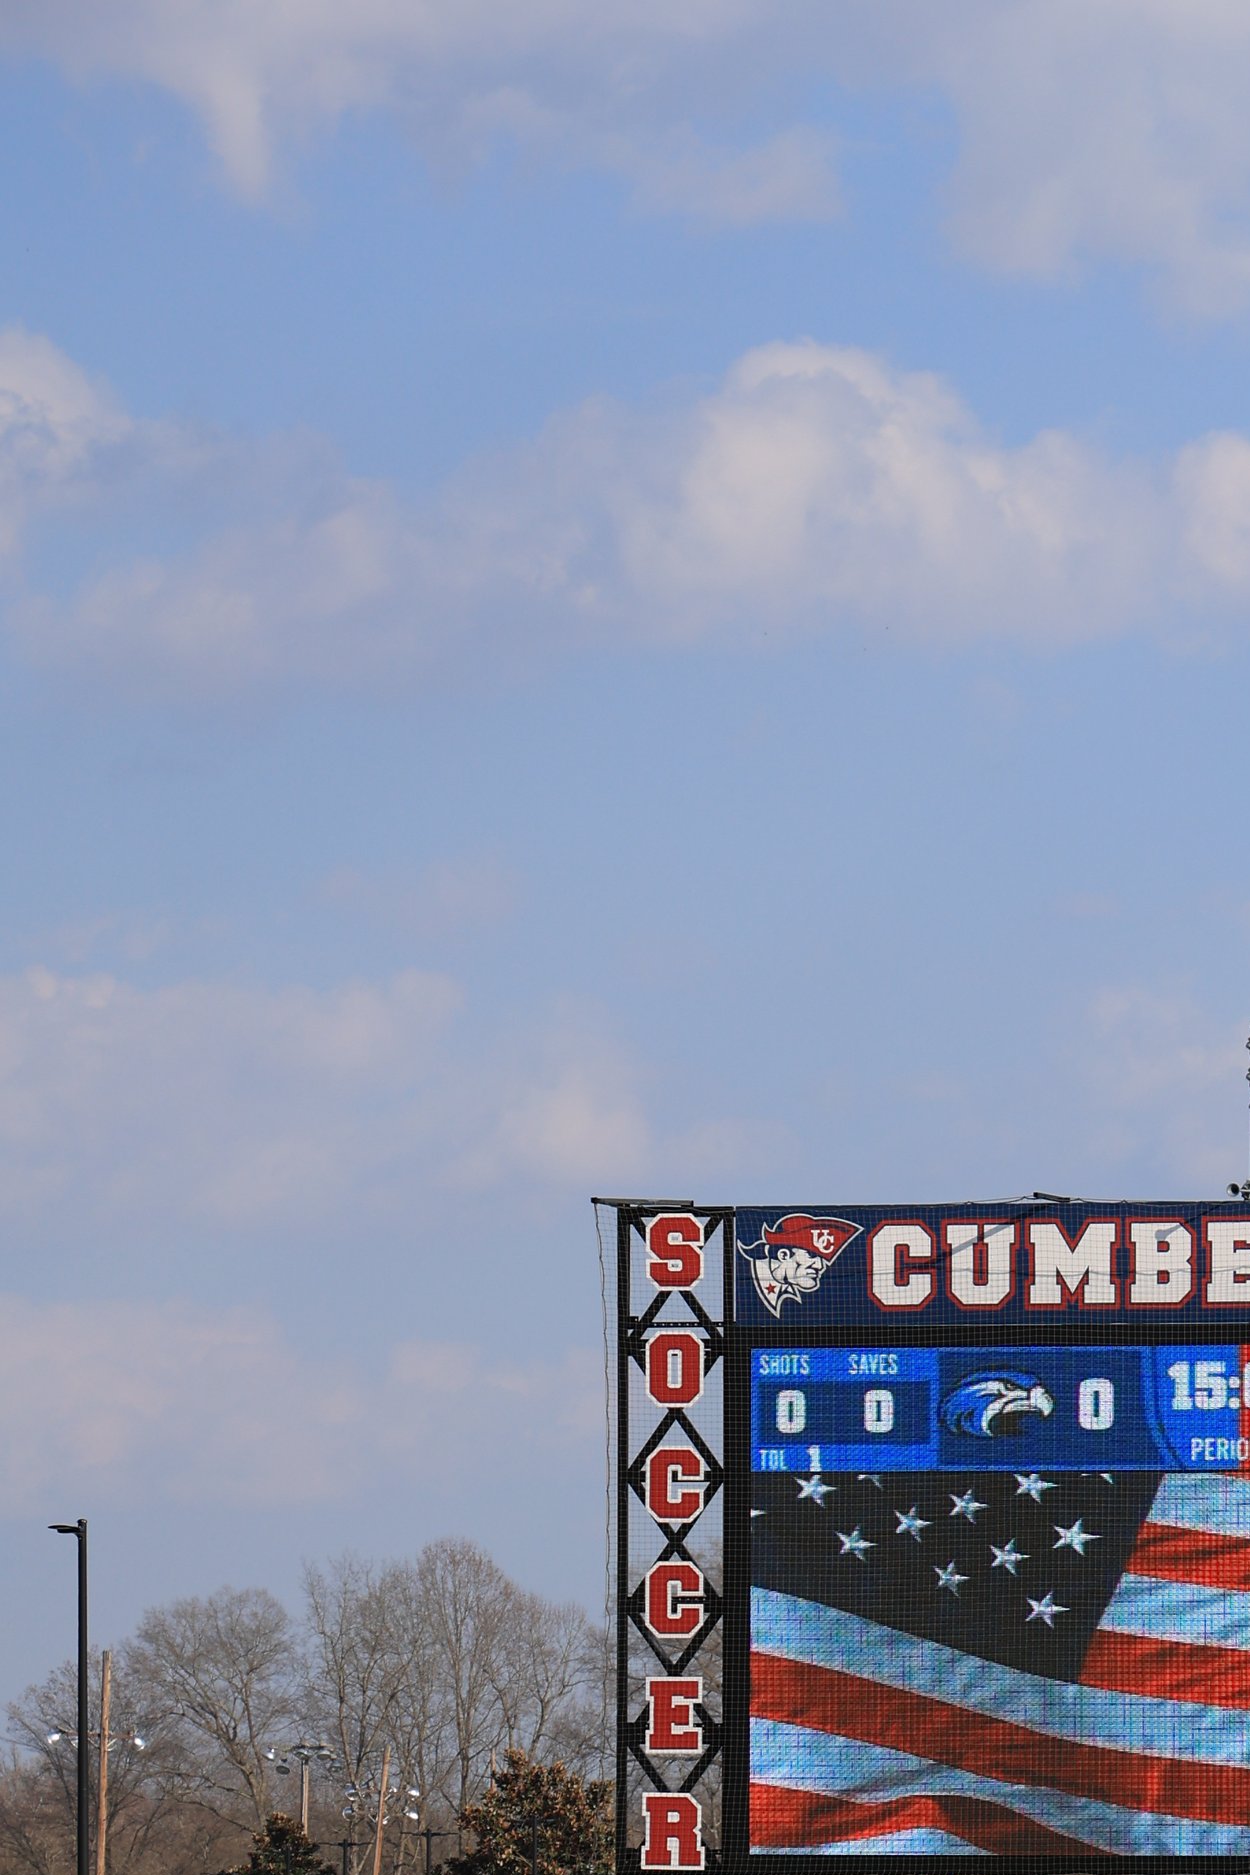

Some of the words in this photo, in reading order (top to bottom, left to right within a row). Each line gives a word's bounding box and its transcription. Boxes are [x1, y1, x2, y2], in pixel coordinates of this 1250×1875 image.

[759, 1354, 810, 1375] SHOTS
[848, 1354, 898, 1375] SAVES
[776, 1390, 806, 1434] 0
[864, 1389, 894, 1433] 0
[1079, 1378, 1115, 1430] 0
[759, 1450, 788, 1471] TOL
[807, 1445, 822, 1472] 1
[641, 1213, 705, 1870] SOCCER
